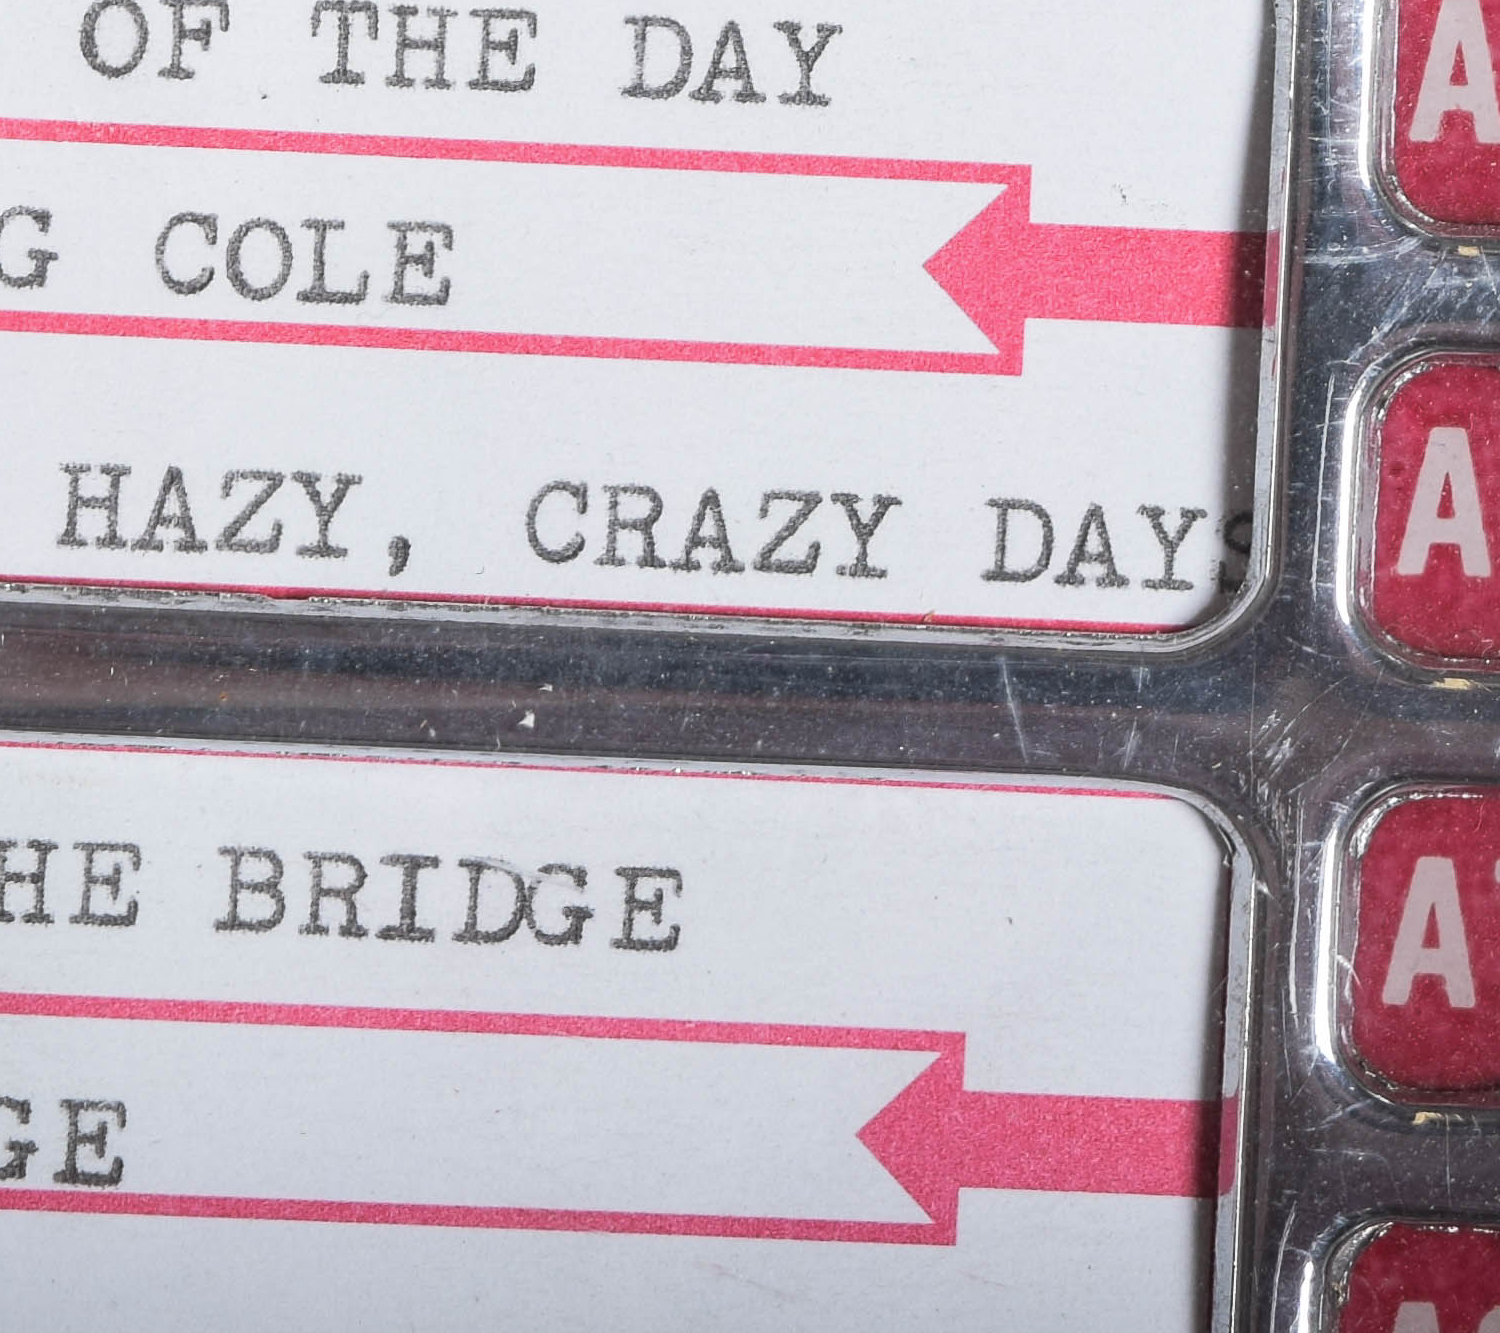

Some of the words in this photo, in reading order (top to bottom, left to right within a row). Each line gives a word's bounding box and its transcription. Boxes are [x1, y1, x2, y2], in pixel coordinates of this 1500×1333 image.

[619, 14, 845, 109] DAY
[153, 210, 455, 308] COLE
[57, 462, 413, 582] HAZY,
[524, 479, 904, 581] CRAZY
[212, 845, 685, 954] BRIDGE
